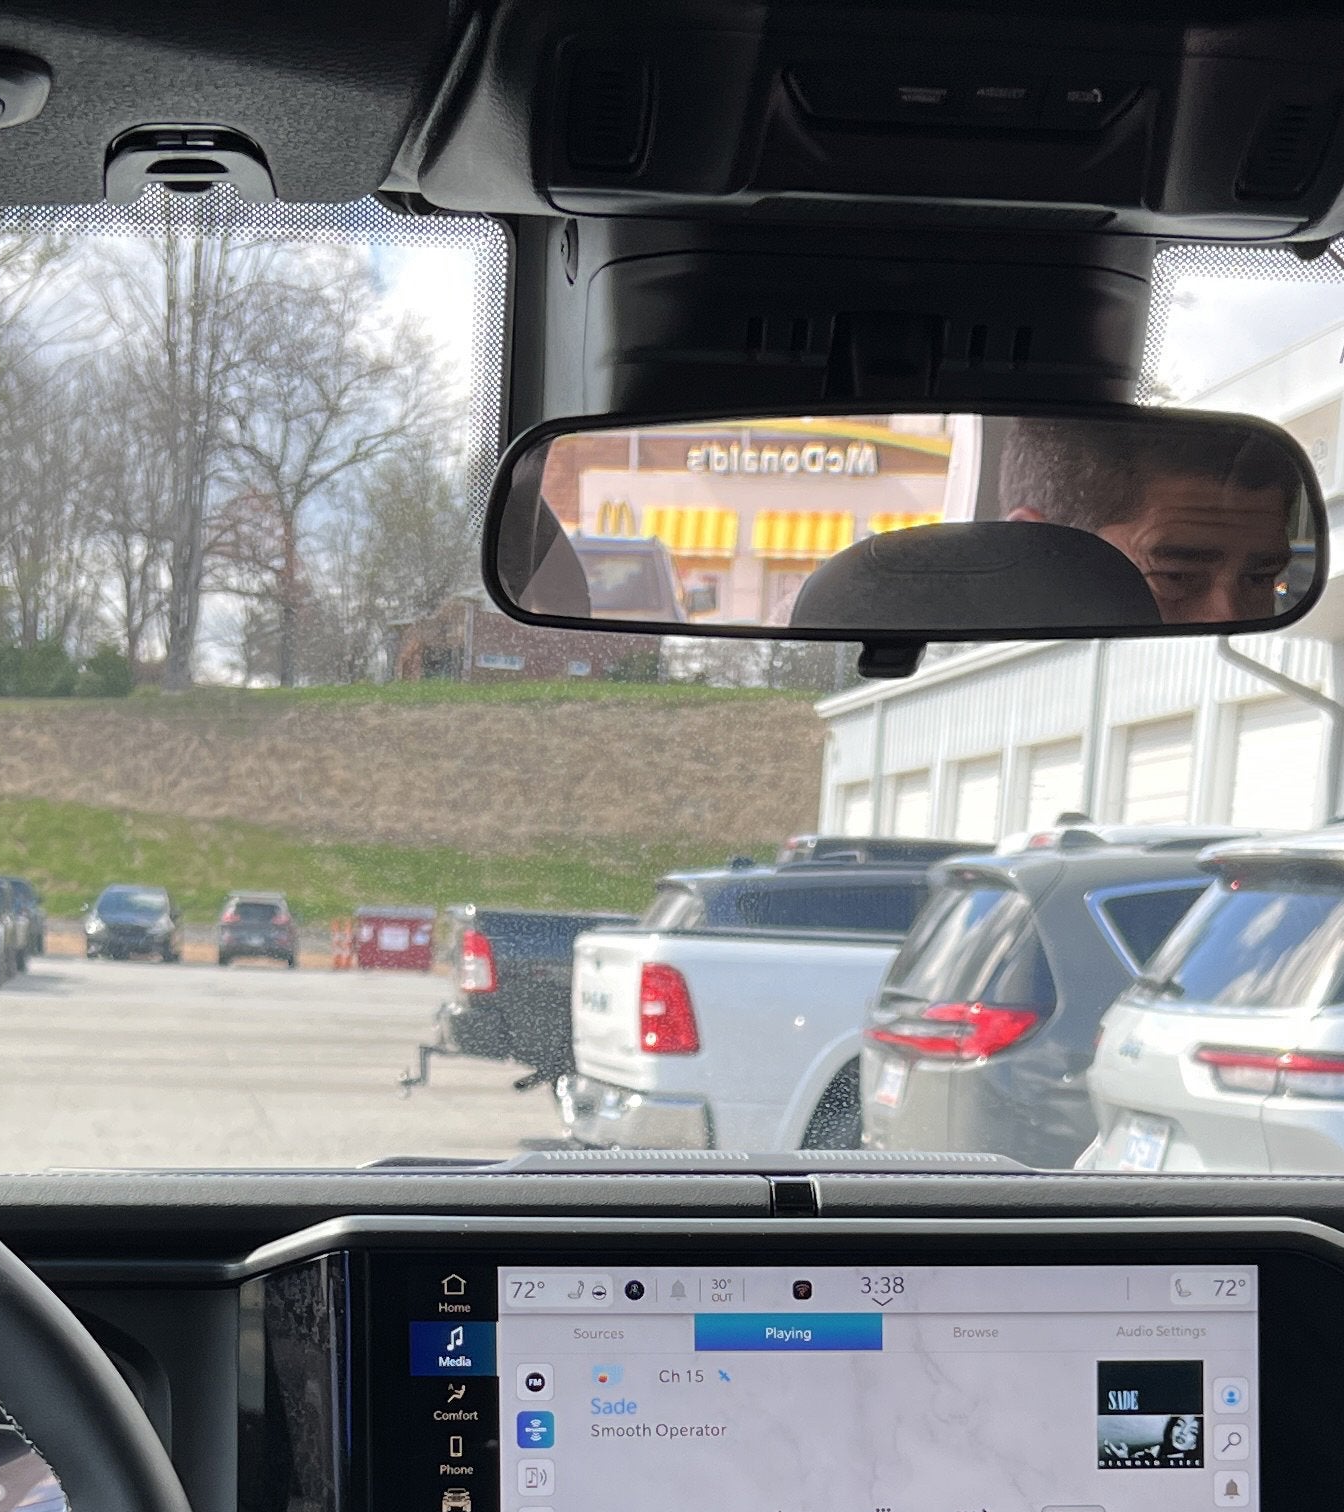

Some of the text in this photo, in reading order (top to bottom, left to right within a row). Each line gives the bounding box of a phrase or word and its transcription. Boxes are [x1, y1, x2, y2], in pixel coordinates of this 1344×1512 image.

[511, 1281, 546, 1299] 72°
[860, 1277, 905, 1295] 3:38
[1213, 1279, 1246, 1297] 72°
[711, 1292, 733, 1302] OUT
[438, 1302, 471, 1313] Home
[573, 1328, 625, 1340] Sources
[765, 1327, 812, 1343] Playing
[953, 1326, 999, 1338] Browse
[1116, 1325, 1207, 1340] Audio Settings
[438, 1356, 471, 1367] Media
[528, 1378, 543, 1387] FM
[658, 1369, 705, 1384] Ch 15
[590, 1398, 638, 1416] Sade
[1108, 1390, 1139, 1411] SADE
[433, 1410, 478, 1422] Comfort
[590, 1423, 727, 1442] Smooth Operator
[439, 1464, 474, 1476] Phone
